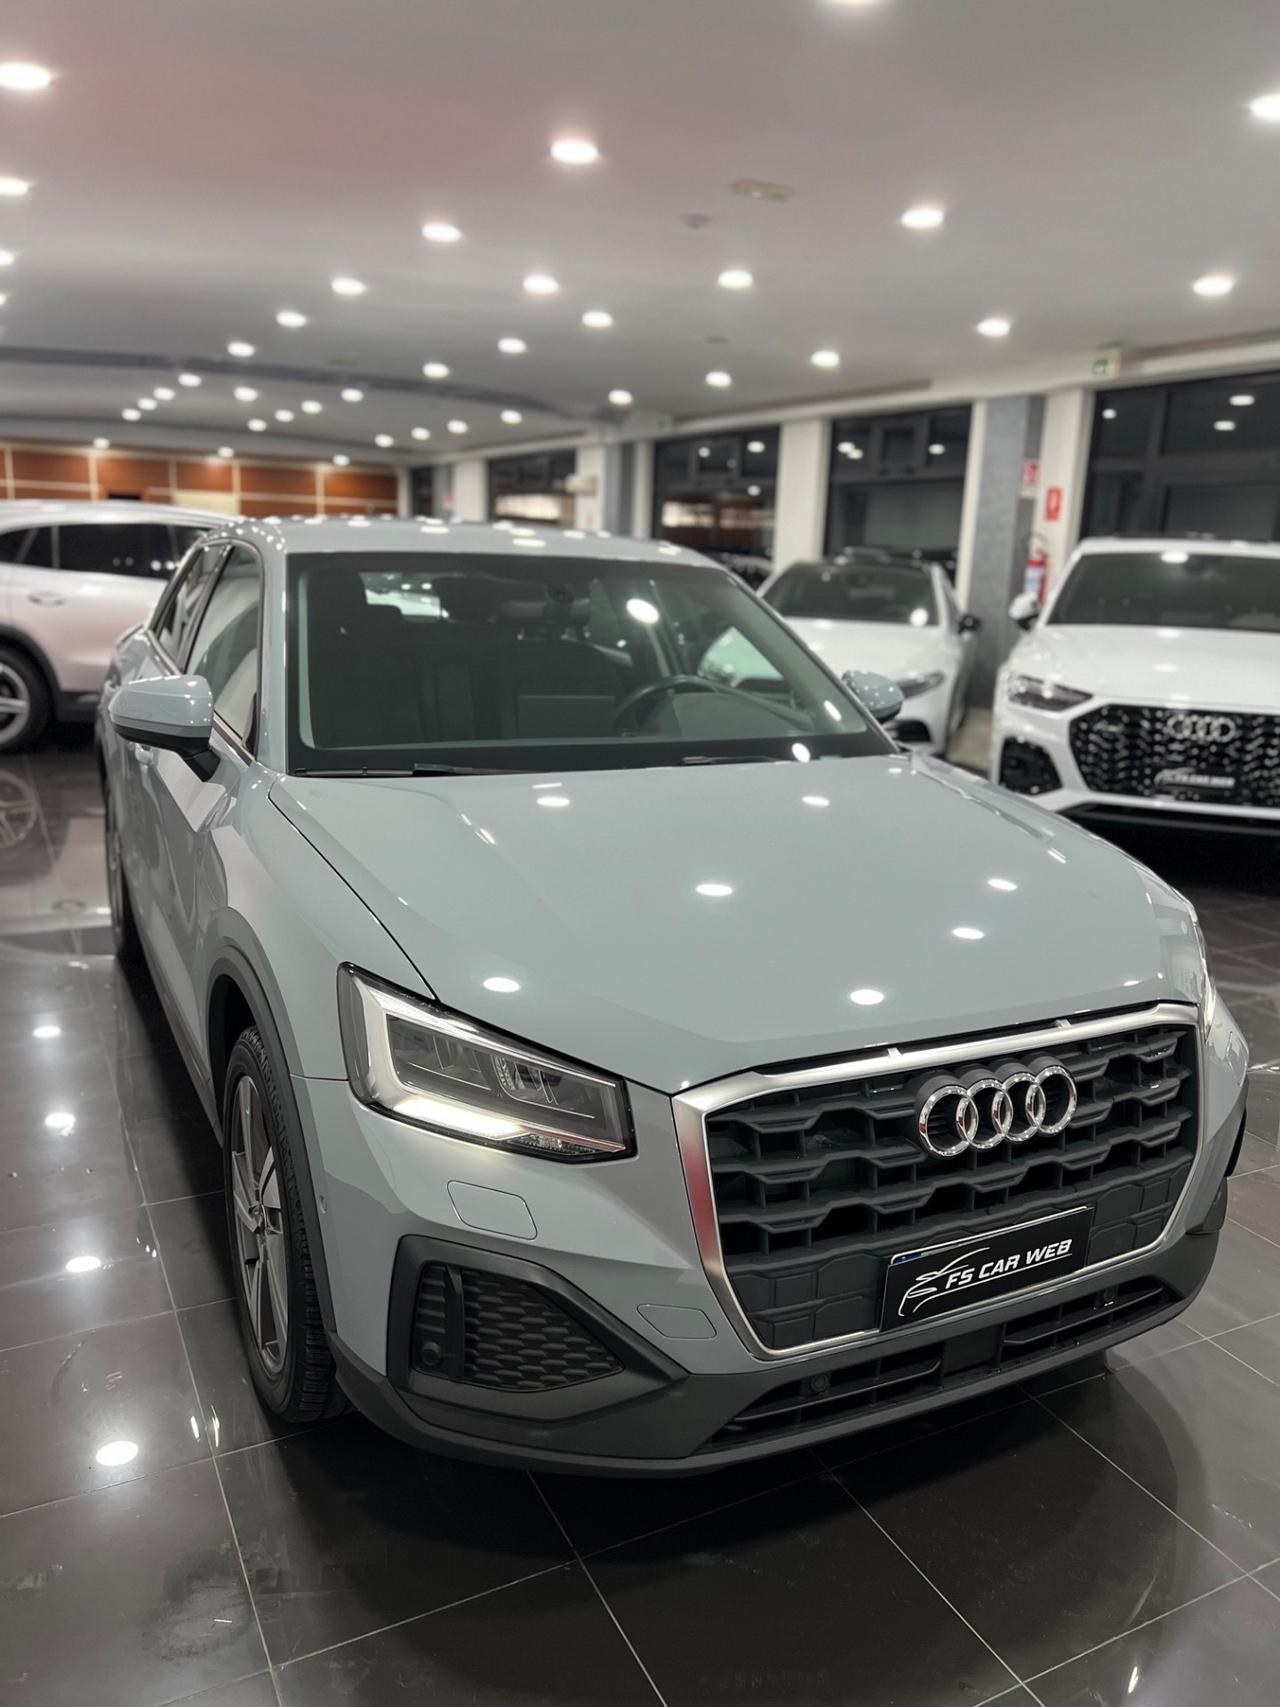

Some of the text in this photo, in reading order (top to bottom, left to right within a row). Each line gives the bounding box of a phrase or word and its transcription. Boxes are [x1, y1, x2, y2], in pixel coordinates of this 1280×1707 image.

[945, 1239, 1073, 1290] FS CAR WEB
